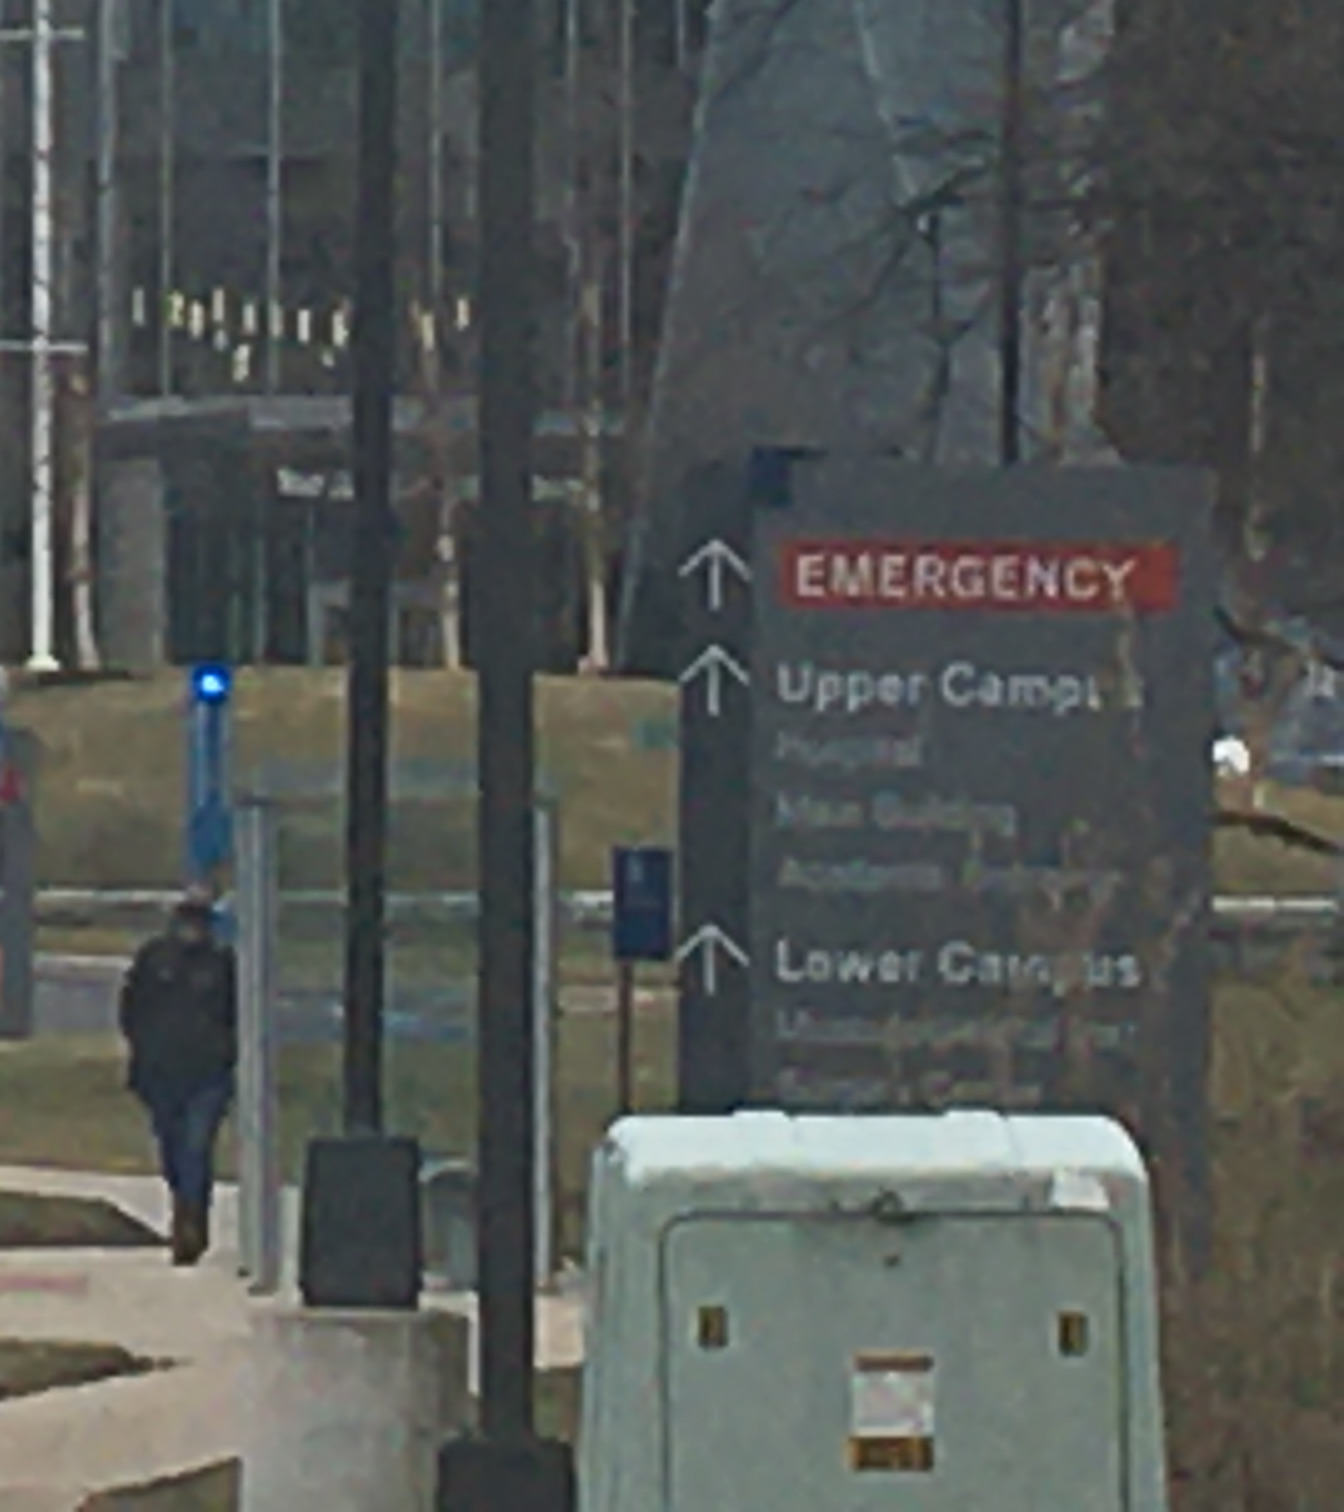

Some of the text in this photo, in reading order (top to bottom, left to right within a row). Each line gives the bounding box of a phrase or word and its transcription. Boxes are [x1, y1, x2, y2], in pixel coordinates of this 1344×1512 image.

[795, 554, 1139, 600] EMERGENCY
[776, 659, 1144, 715] Upper Camp
[775, 937, 1144, 996] Lower Camus
